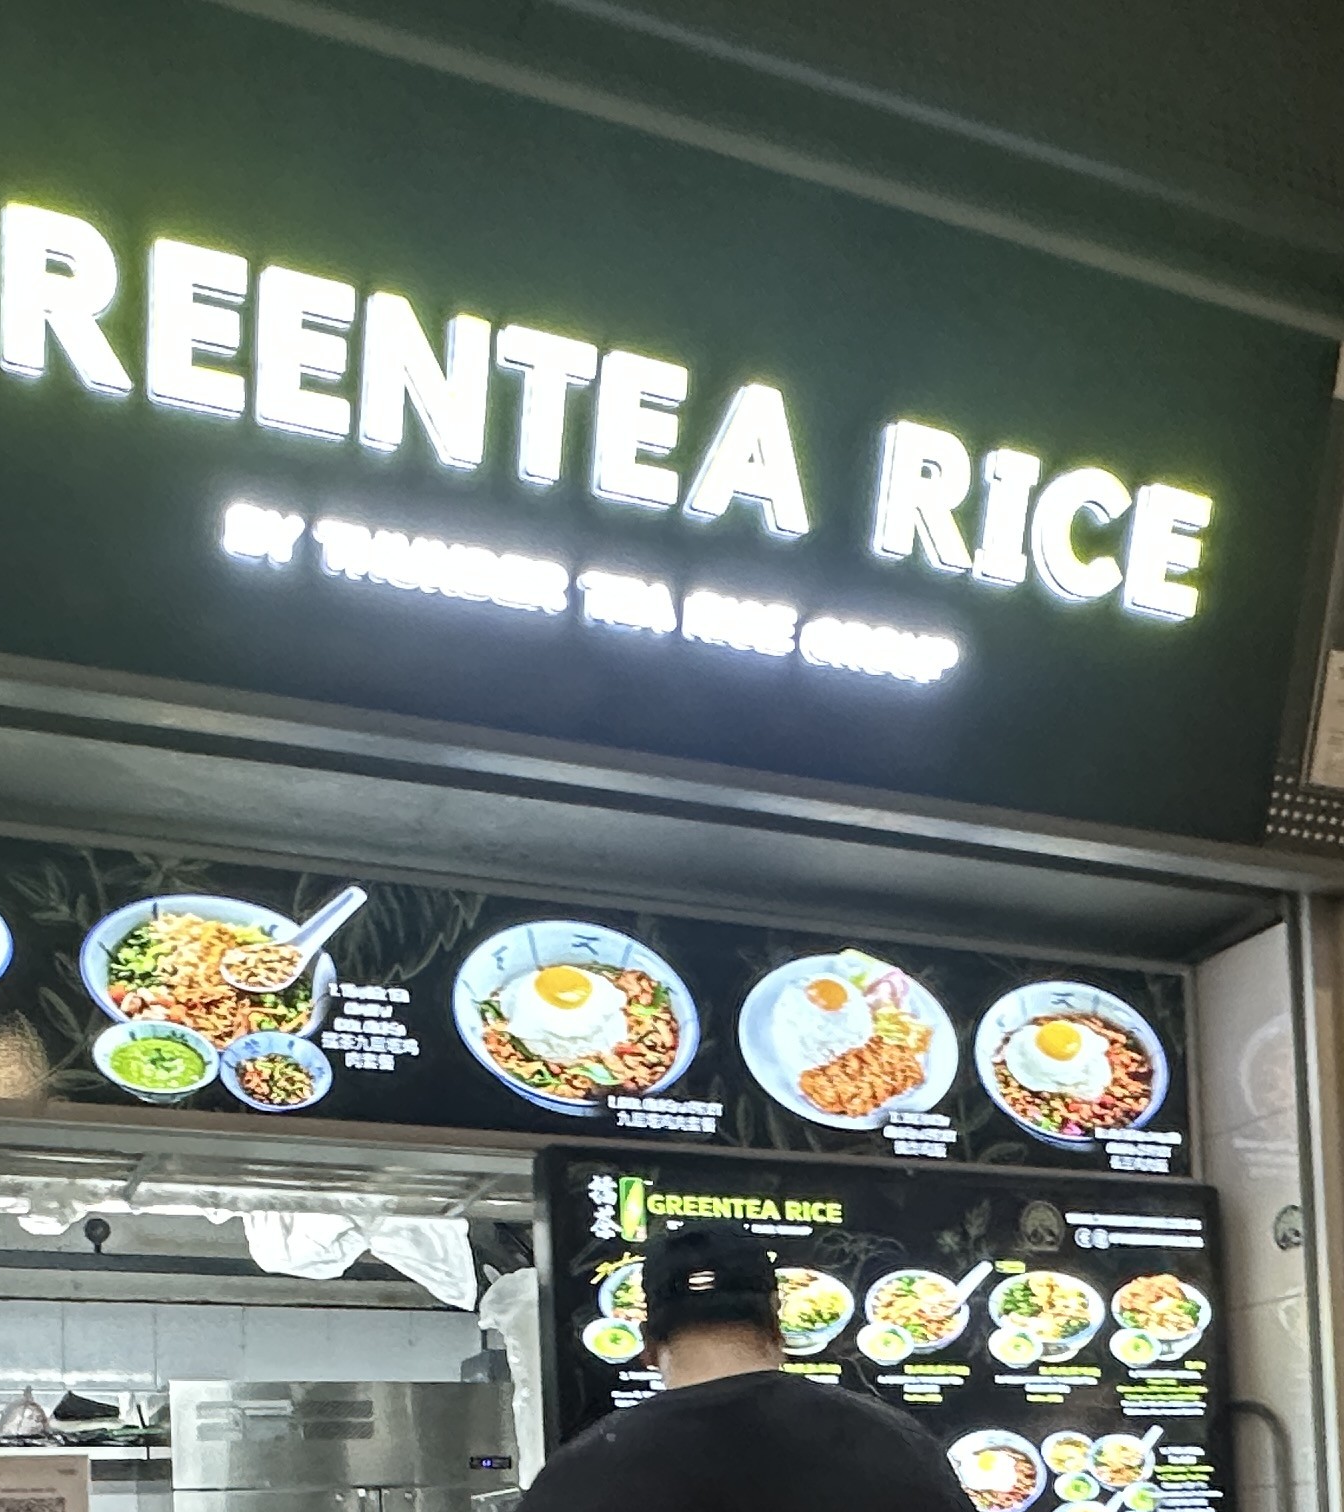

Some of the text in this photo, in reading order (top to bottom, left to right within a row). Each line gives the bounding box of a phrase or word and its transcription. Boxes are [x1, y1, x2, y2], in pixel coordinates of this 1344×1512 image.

[872, 420, 1214, 622] RICE
[646, 1194, 844, 1224] GREENTEA RICE
